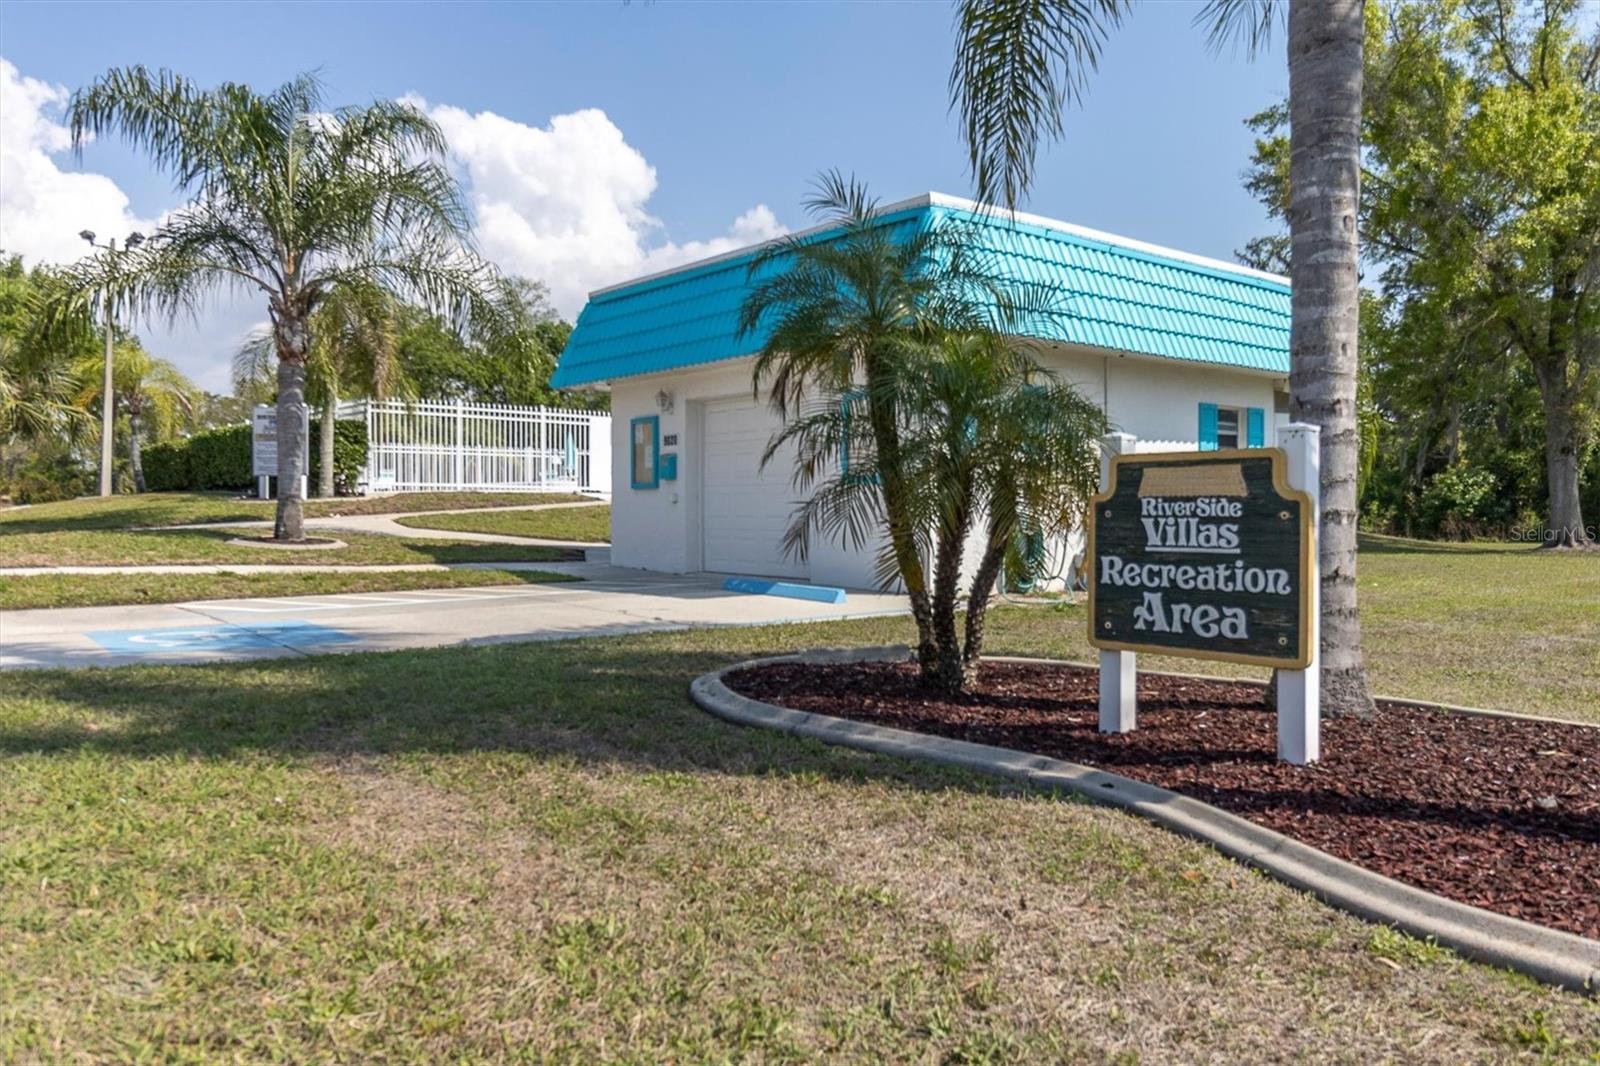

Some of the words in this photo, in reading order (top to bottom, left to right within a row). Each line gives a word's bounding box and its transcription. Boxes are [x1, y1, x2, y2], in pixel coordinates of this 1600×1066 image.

[1141, 517, 1240, 548] Villas
[1100, 555, 1291, 595] Recreation
[1133, 591, 1248, 640] Area
